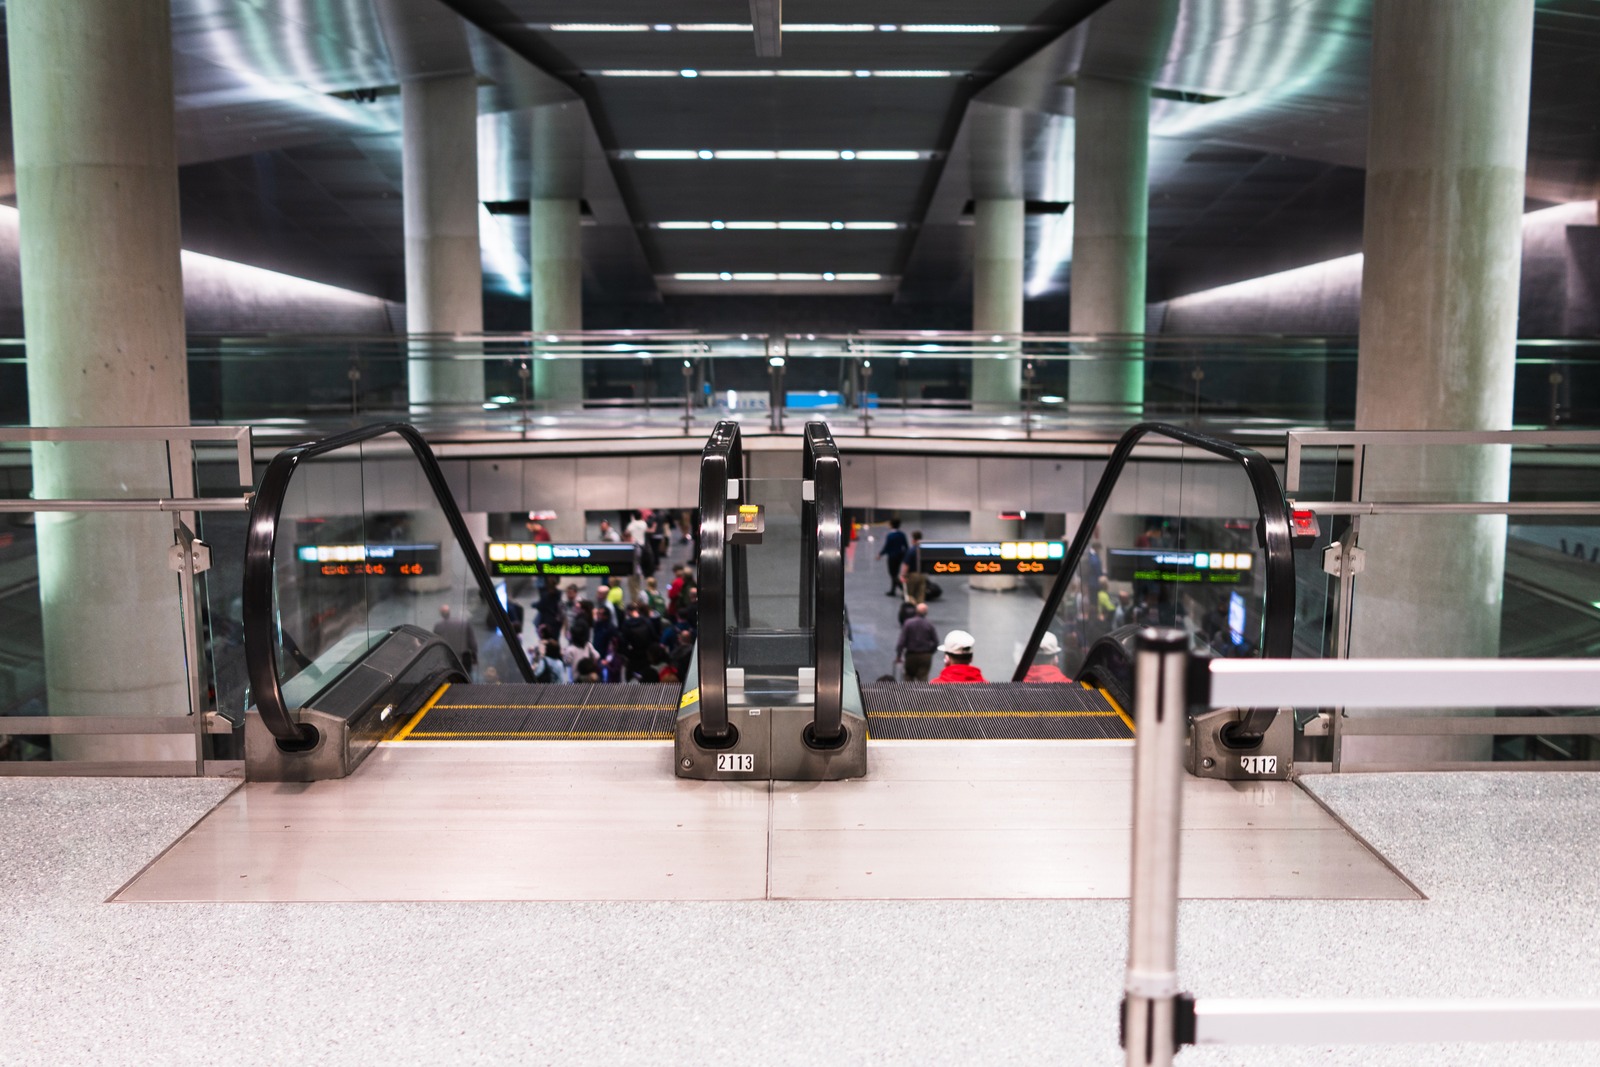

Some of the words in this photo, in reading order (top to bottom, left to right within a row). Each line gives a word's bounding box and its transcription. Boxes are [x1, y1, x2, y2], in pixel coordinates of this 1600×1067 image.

[498, 563, 538, 574] Terminal
[718, 755, 752, 770] 2113
[1242, 757, 1276, 773] 2112
